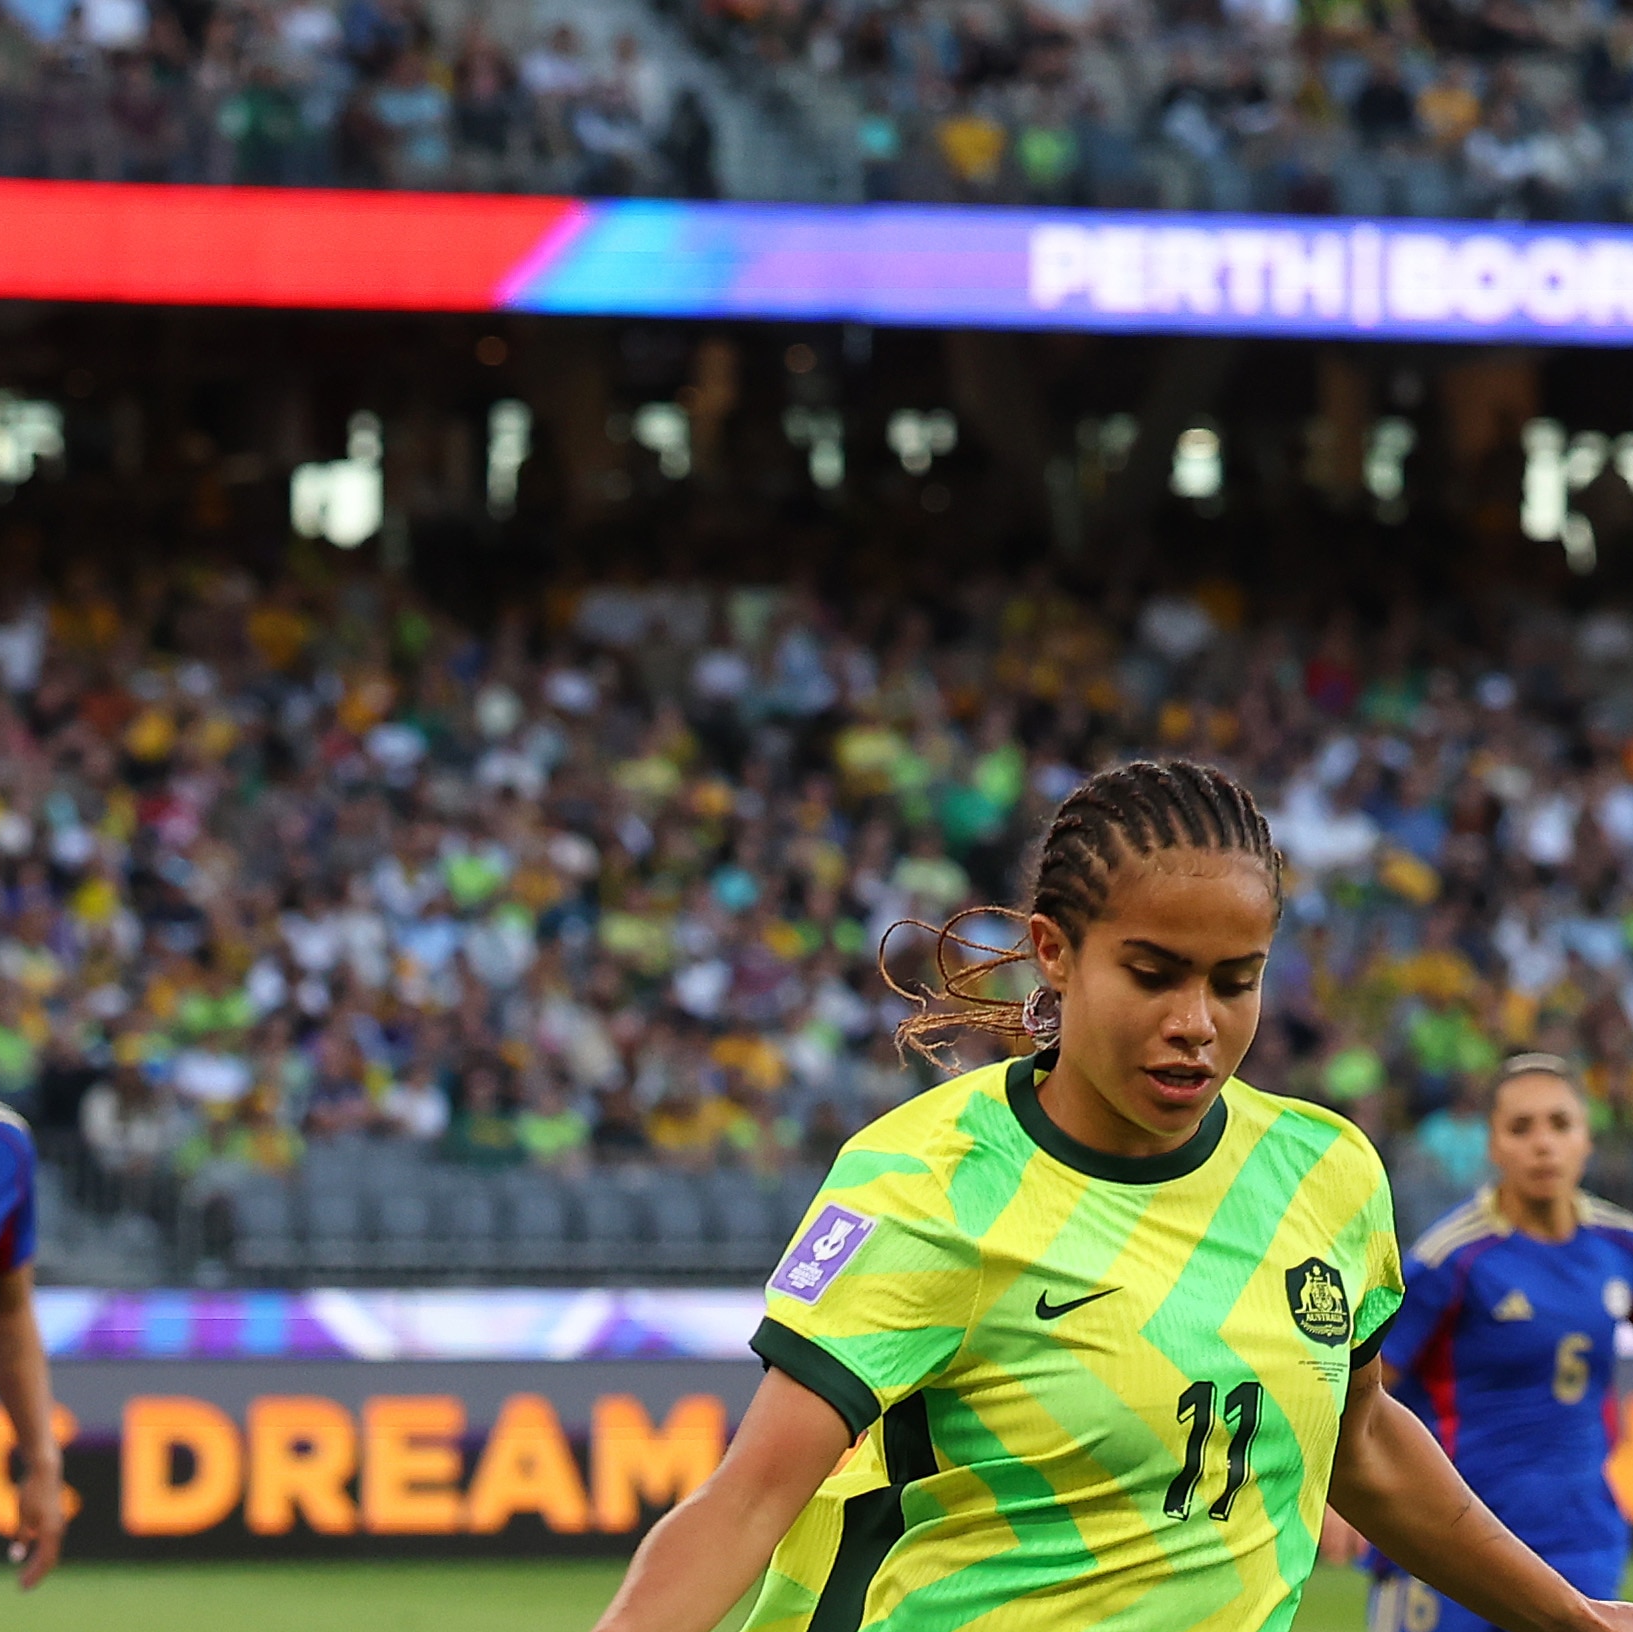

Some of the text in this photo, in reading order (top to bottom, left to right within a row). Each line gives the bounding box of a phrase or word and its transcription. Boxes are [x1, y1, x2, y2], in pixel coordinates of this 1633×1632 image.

[1551, 1332, 1593, 1406] 6
[117, 1391, 726, 1538] DREAM
[1163, 1380, 1264, 1522] 11
